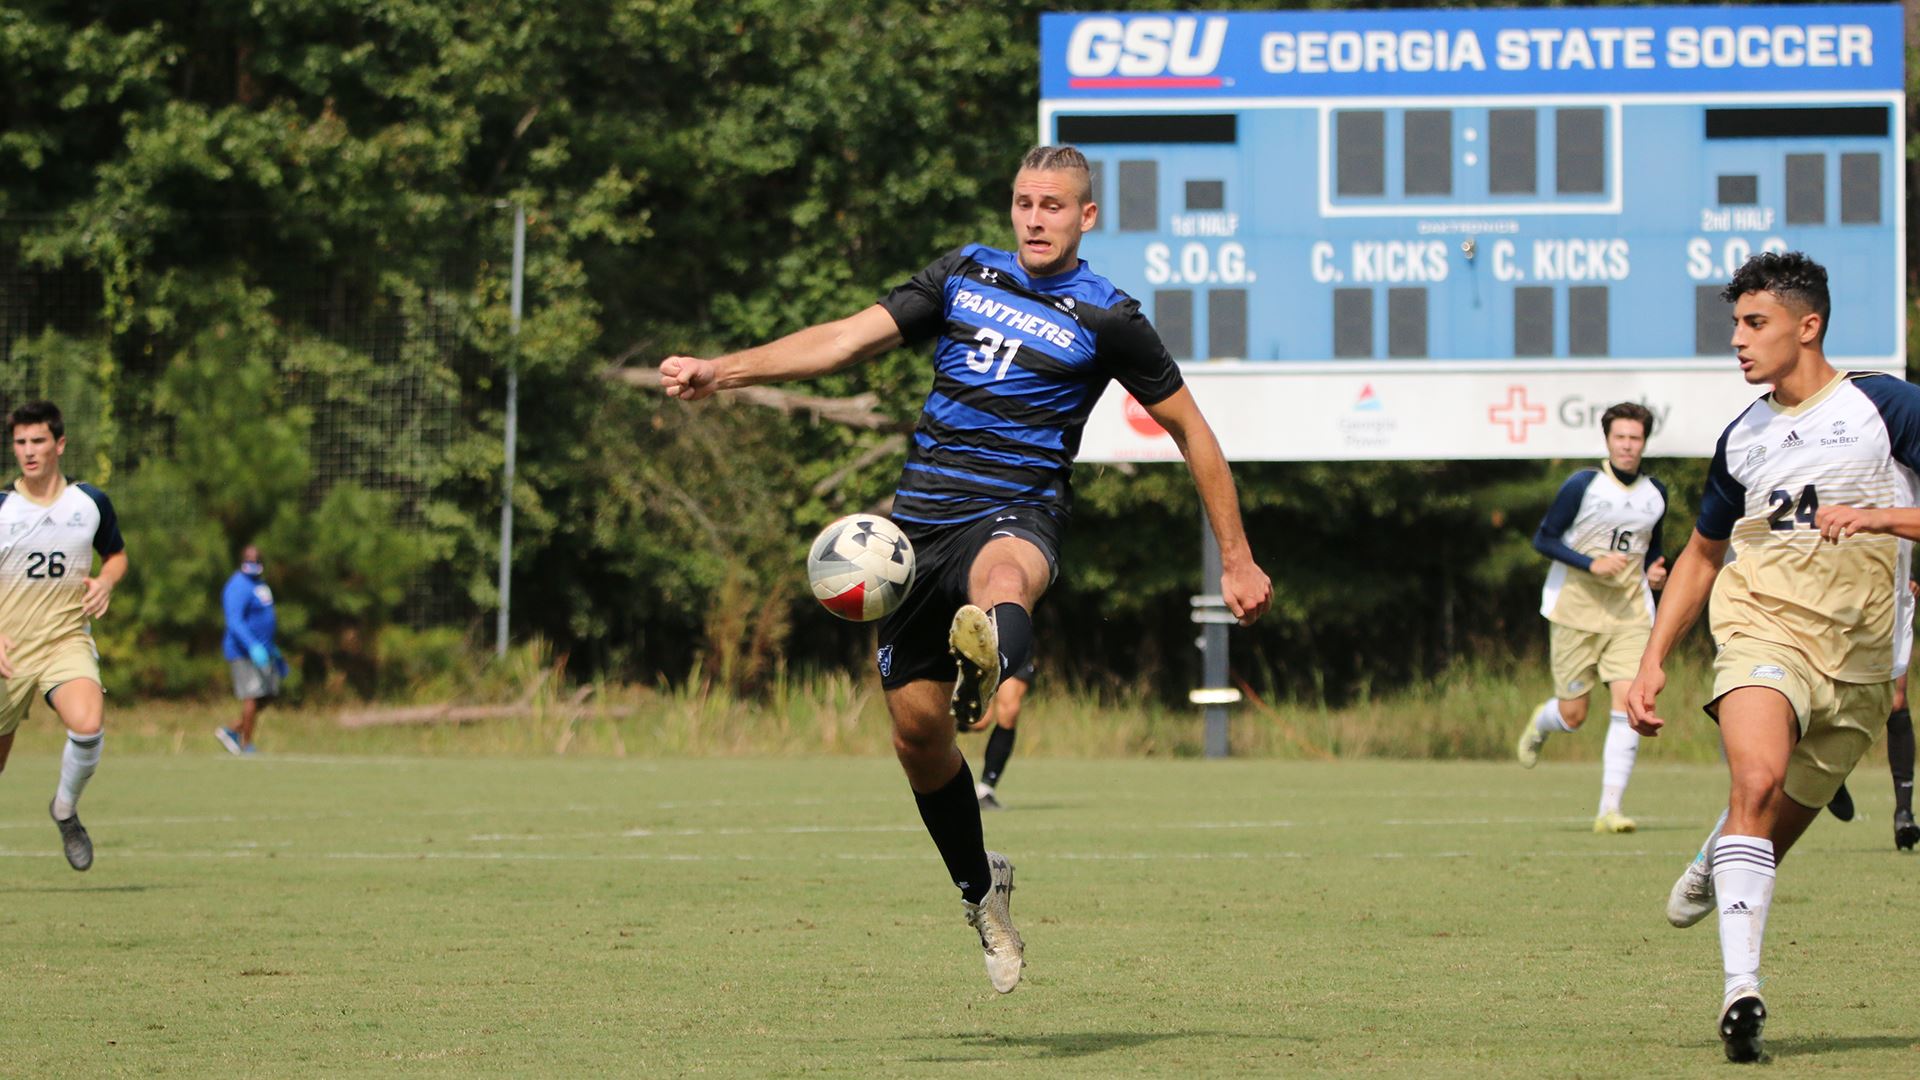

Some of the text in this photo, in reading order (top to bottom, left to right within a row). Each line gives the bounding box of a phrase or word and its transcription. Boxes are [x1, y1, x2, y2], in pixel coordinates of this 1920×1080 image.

[1065, 16, 1229, 77] GSU
[1260, 24, 1874, 73] GEORGIA STATE SOCCER
[1171, 211, 1239, 237] 1st HALF
[1701, 206, 1775, 231] 2nd HALF
[1145, 241, 1257, 284] S.O.G.
[1311, 239, 1449, 283] C. KICKS
[1492, 237, 1631, 282] C. KICKS
[953, 289, 1077, 349] PANTHERS
[966, 327, 1023, 381] 31
[1558, 394, 1671, 437] Gry
[1780, 439, 1804, 449] adidas
[1767, 484, 1819, 531] 24
[1609, 527, 1633, 552] 16
[27, 551, 66, 578] 26
